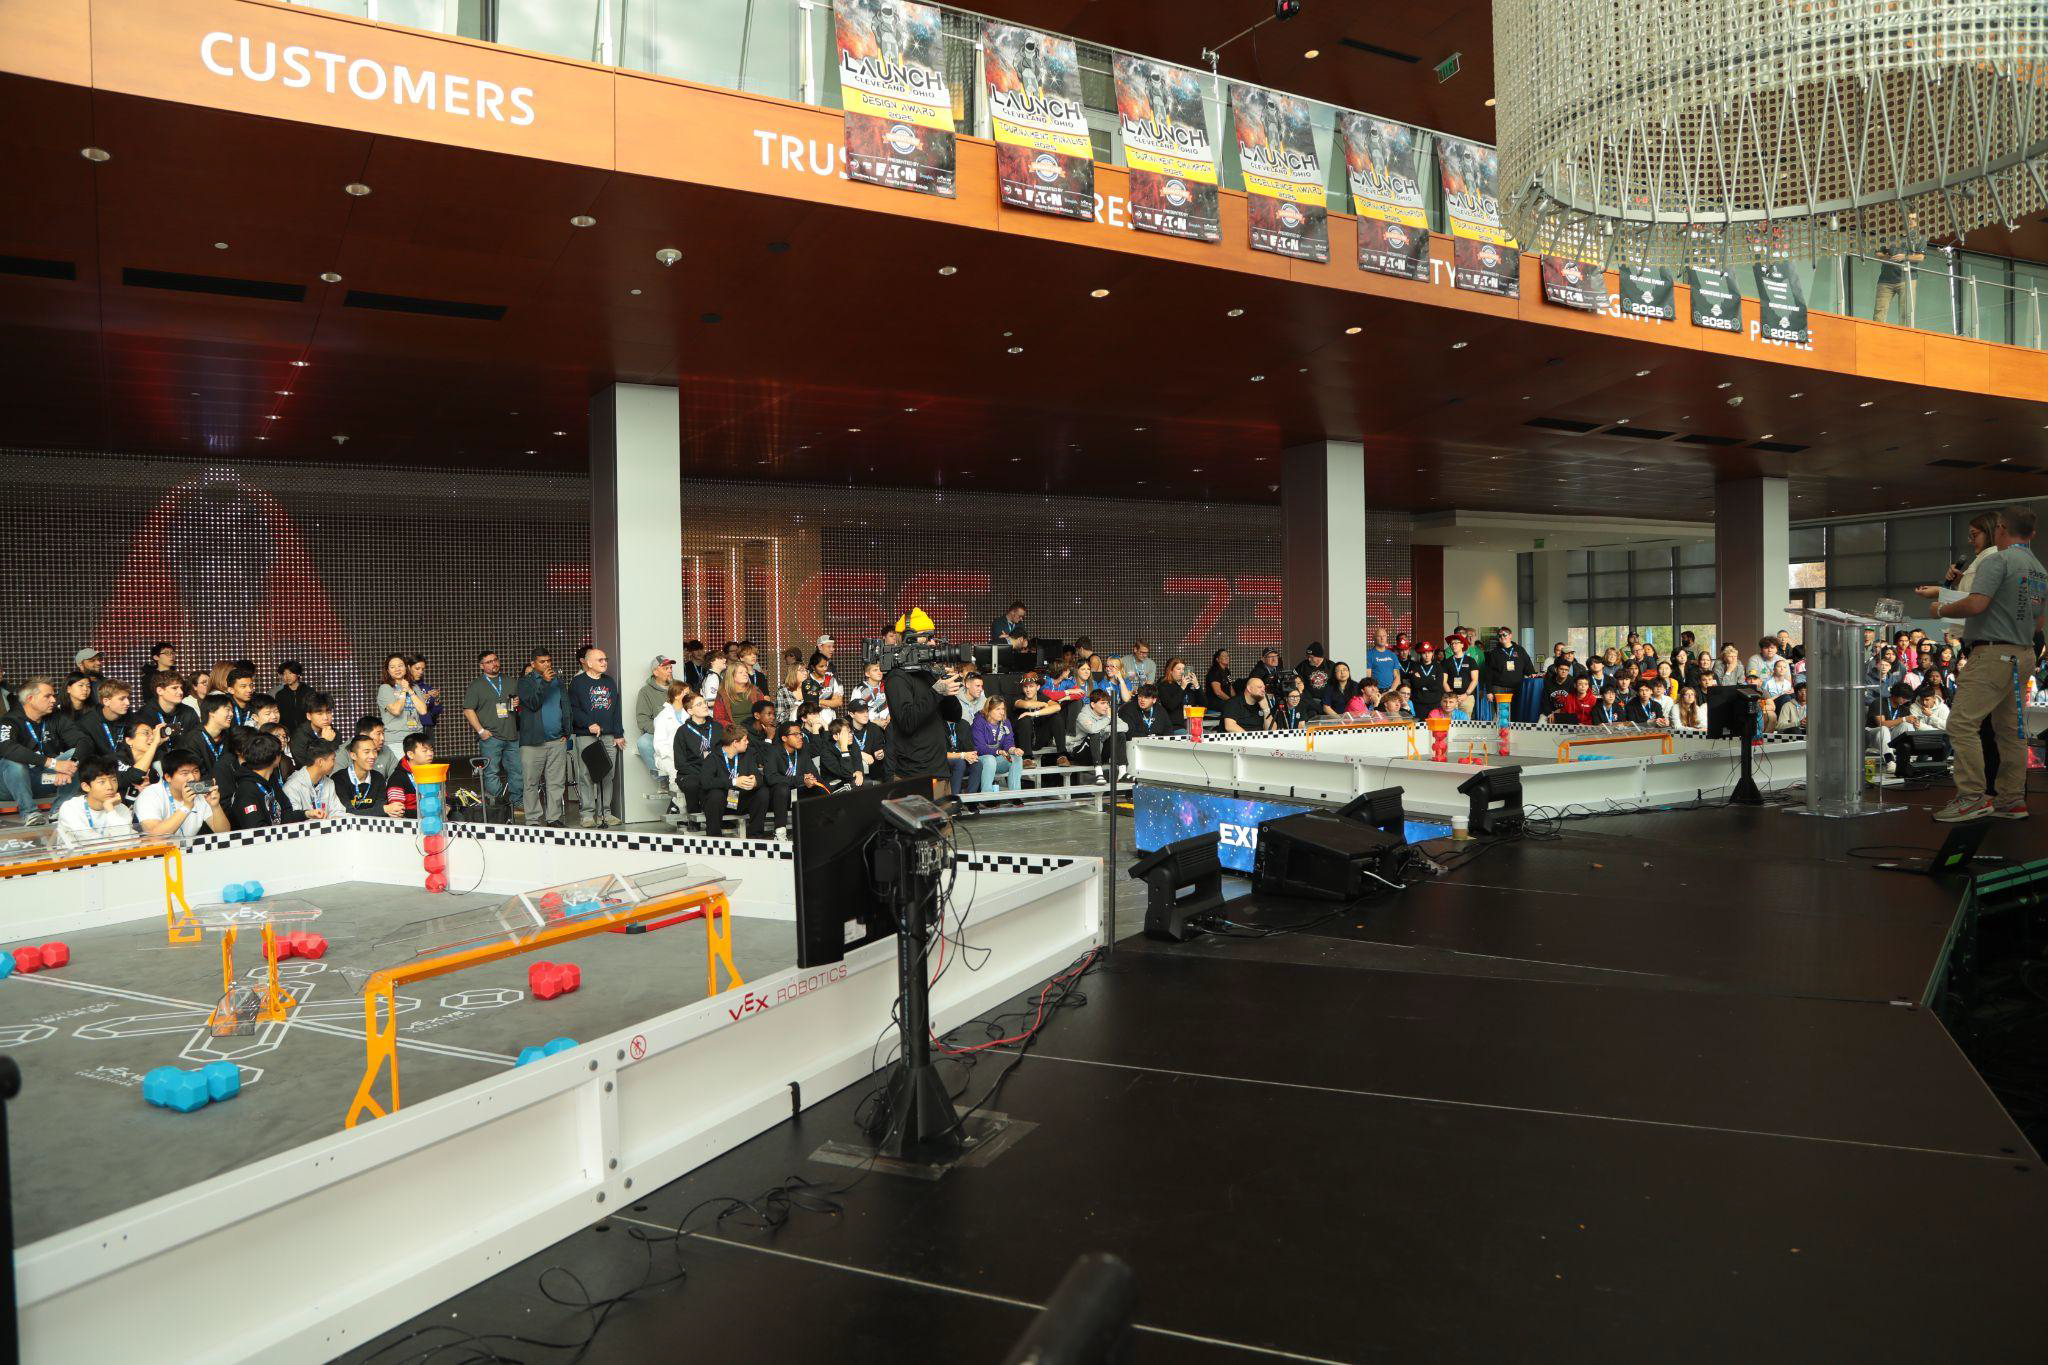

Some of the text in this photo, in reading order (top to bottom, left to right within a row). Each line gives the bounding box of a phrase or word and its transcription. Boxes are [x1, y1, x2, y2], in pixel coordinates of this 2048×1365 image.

[200, 31, 535, 126] CUSTOMERS
[843, 51, 943, 91] LAUNCH
[855, 75, 935, 98] CLEVELAND OHIO
[862, 94, 935, 117] DESIGN AWARD
[991, 84, 1080, 120] LAUNCH
[888, 111, 914, 122] 2025
[1003, 107, 1074, 128] CLEVELAND OHIO
[1123, 115, 1204, 147] LAUNCH
[1241, 142, 1316, 171] LAUNCH
[1350, 166, 1417, 195] LAUNCH
[1632, 302, 1664, 317] 2025
[1701, 315, 1733, 330] 2025
[1770, 328, 1799, 340] 2025
[221, 906, 269, 921] VEX
[729, 964, 848, 1020] VEX ROBOTICS
